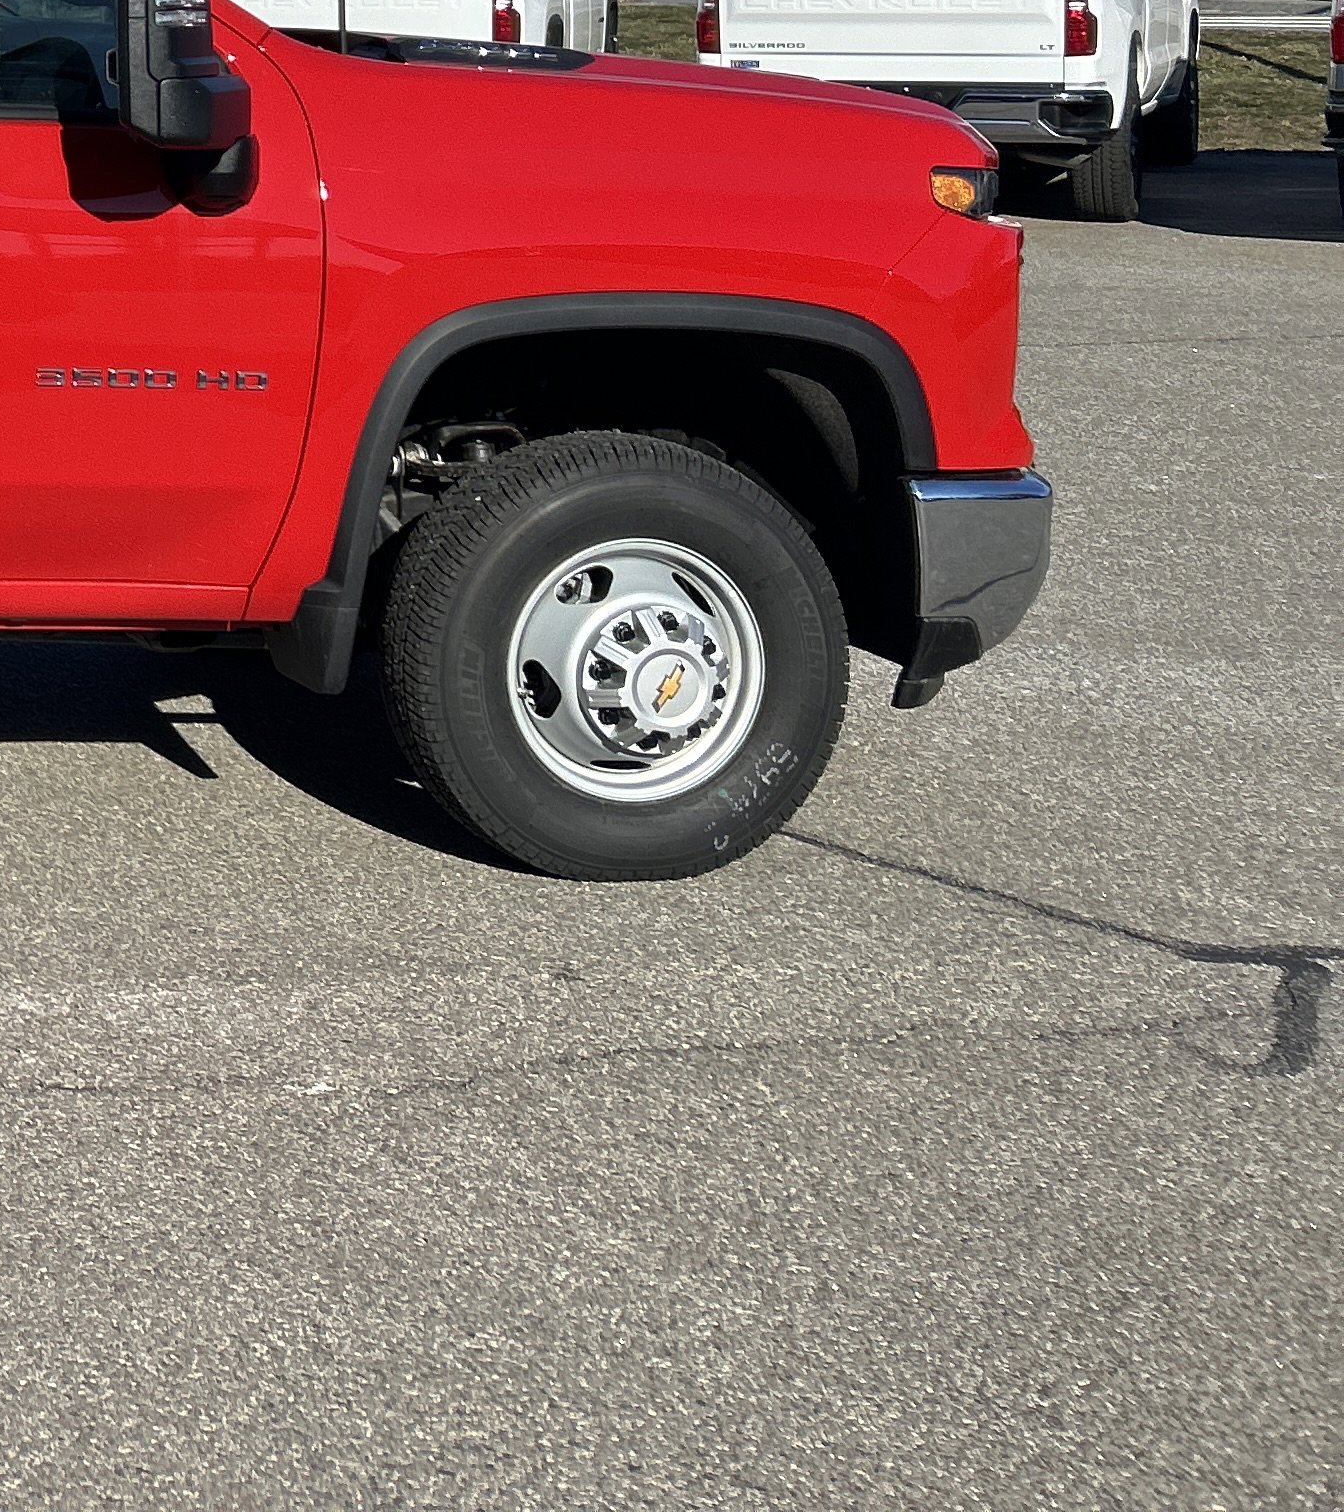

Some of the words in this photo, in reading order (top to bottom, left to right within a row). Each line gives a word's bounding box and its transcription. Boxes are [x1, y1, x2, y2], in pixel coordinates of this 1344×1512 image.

[728, 42, 806, 50] SILVERADO
[35, 367, 178, 389] 3500
[196, 369, 269, 391] HD
